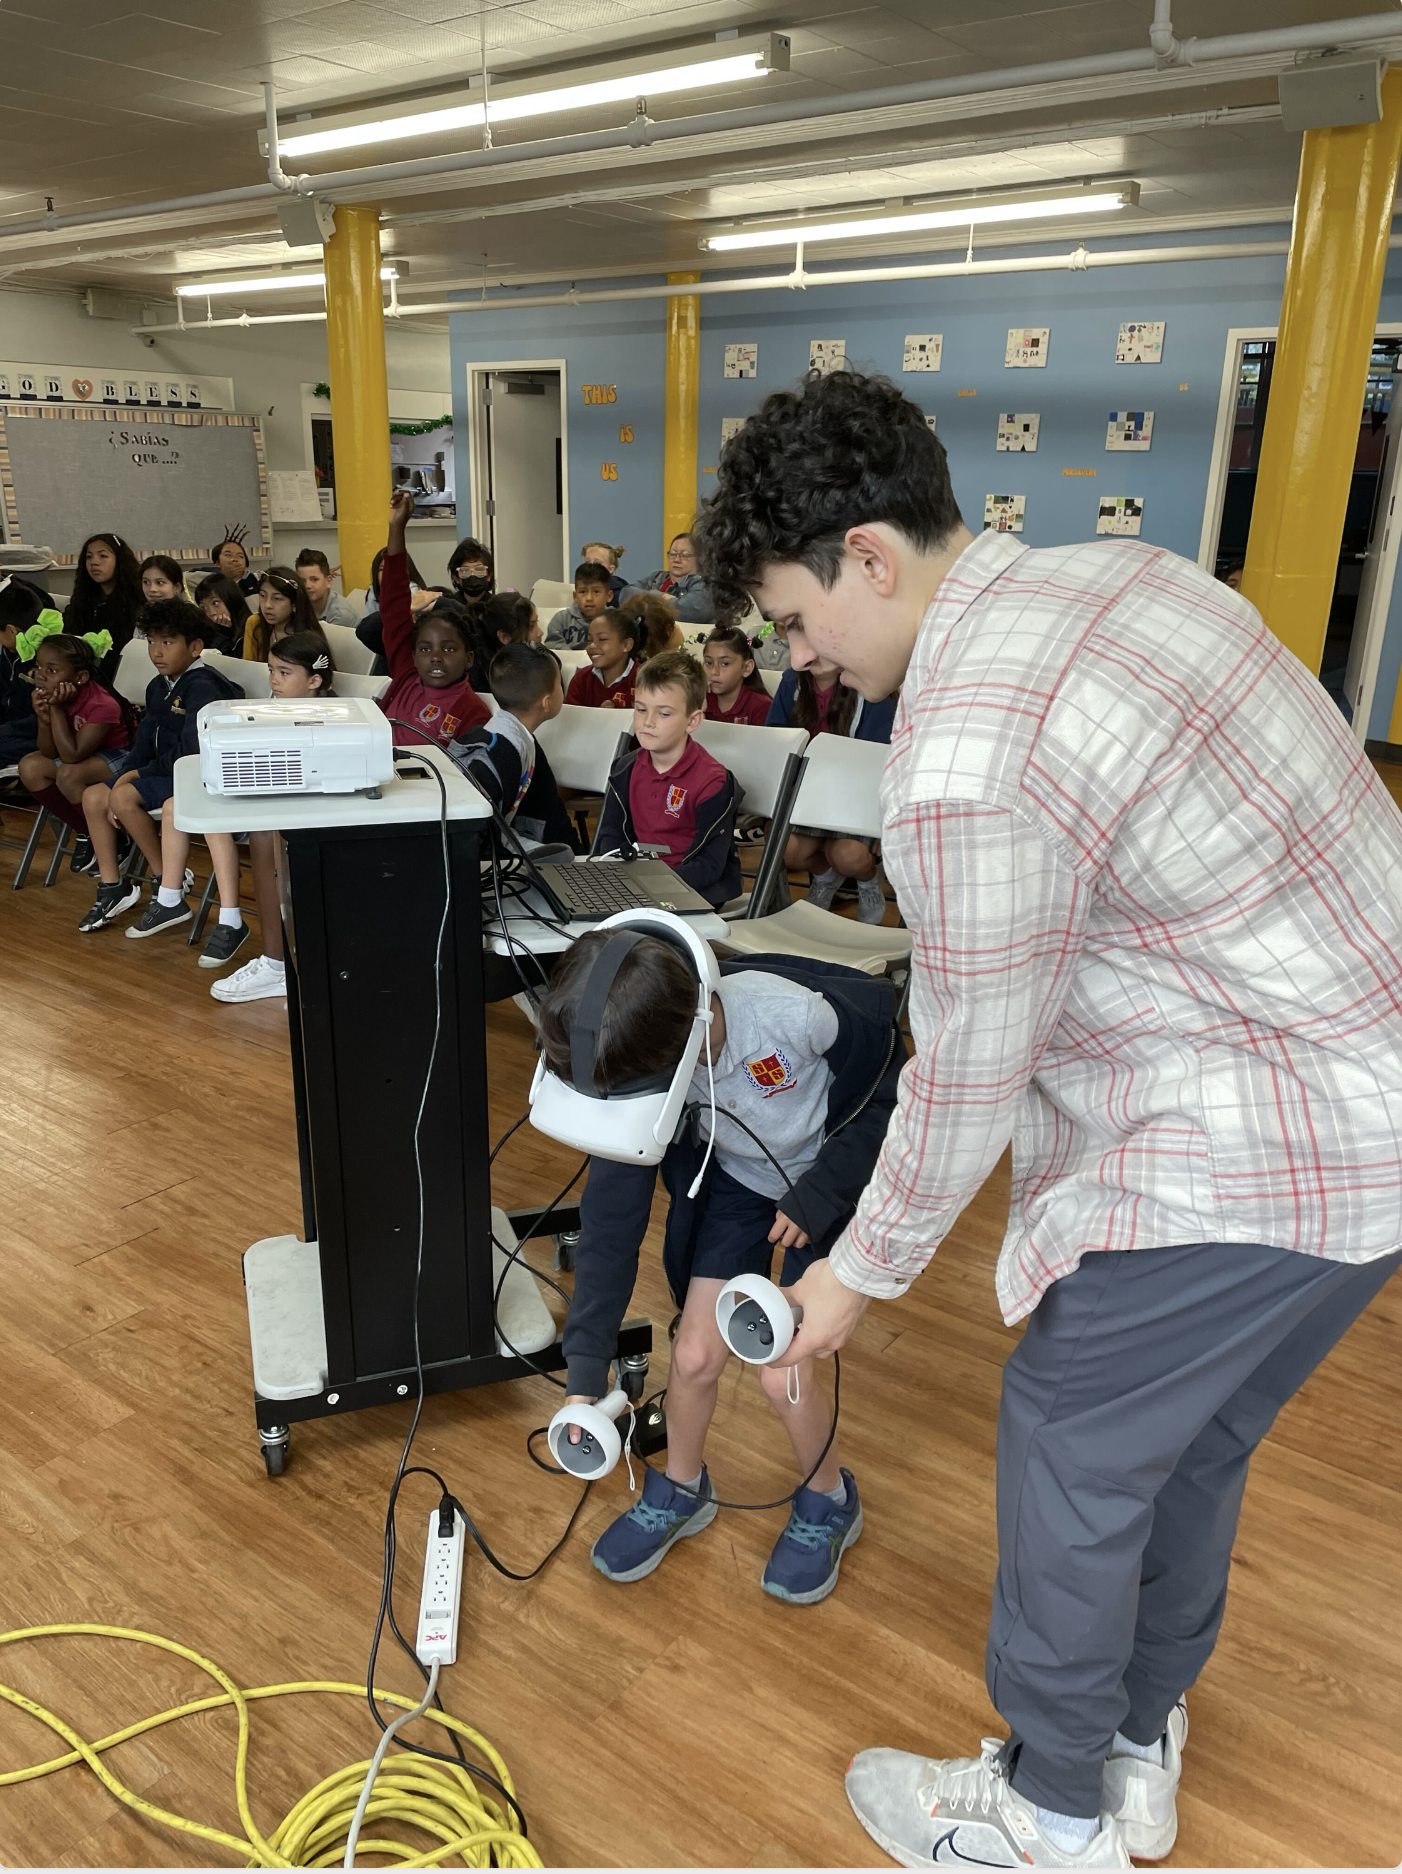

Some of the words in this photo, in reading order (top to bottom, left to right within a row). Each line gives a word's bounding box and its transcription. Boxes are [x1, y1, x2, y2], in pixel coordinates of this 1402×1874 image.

[105, 385, 198, 400] BLESS
[581, 384, 617, 405] THIS
[601, 463, 619, 481] US
[425, 1634, 447, 1642] APC
